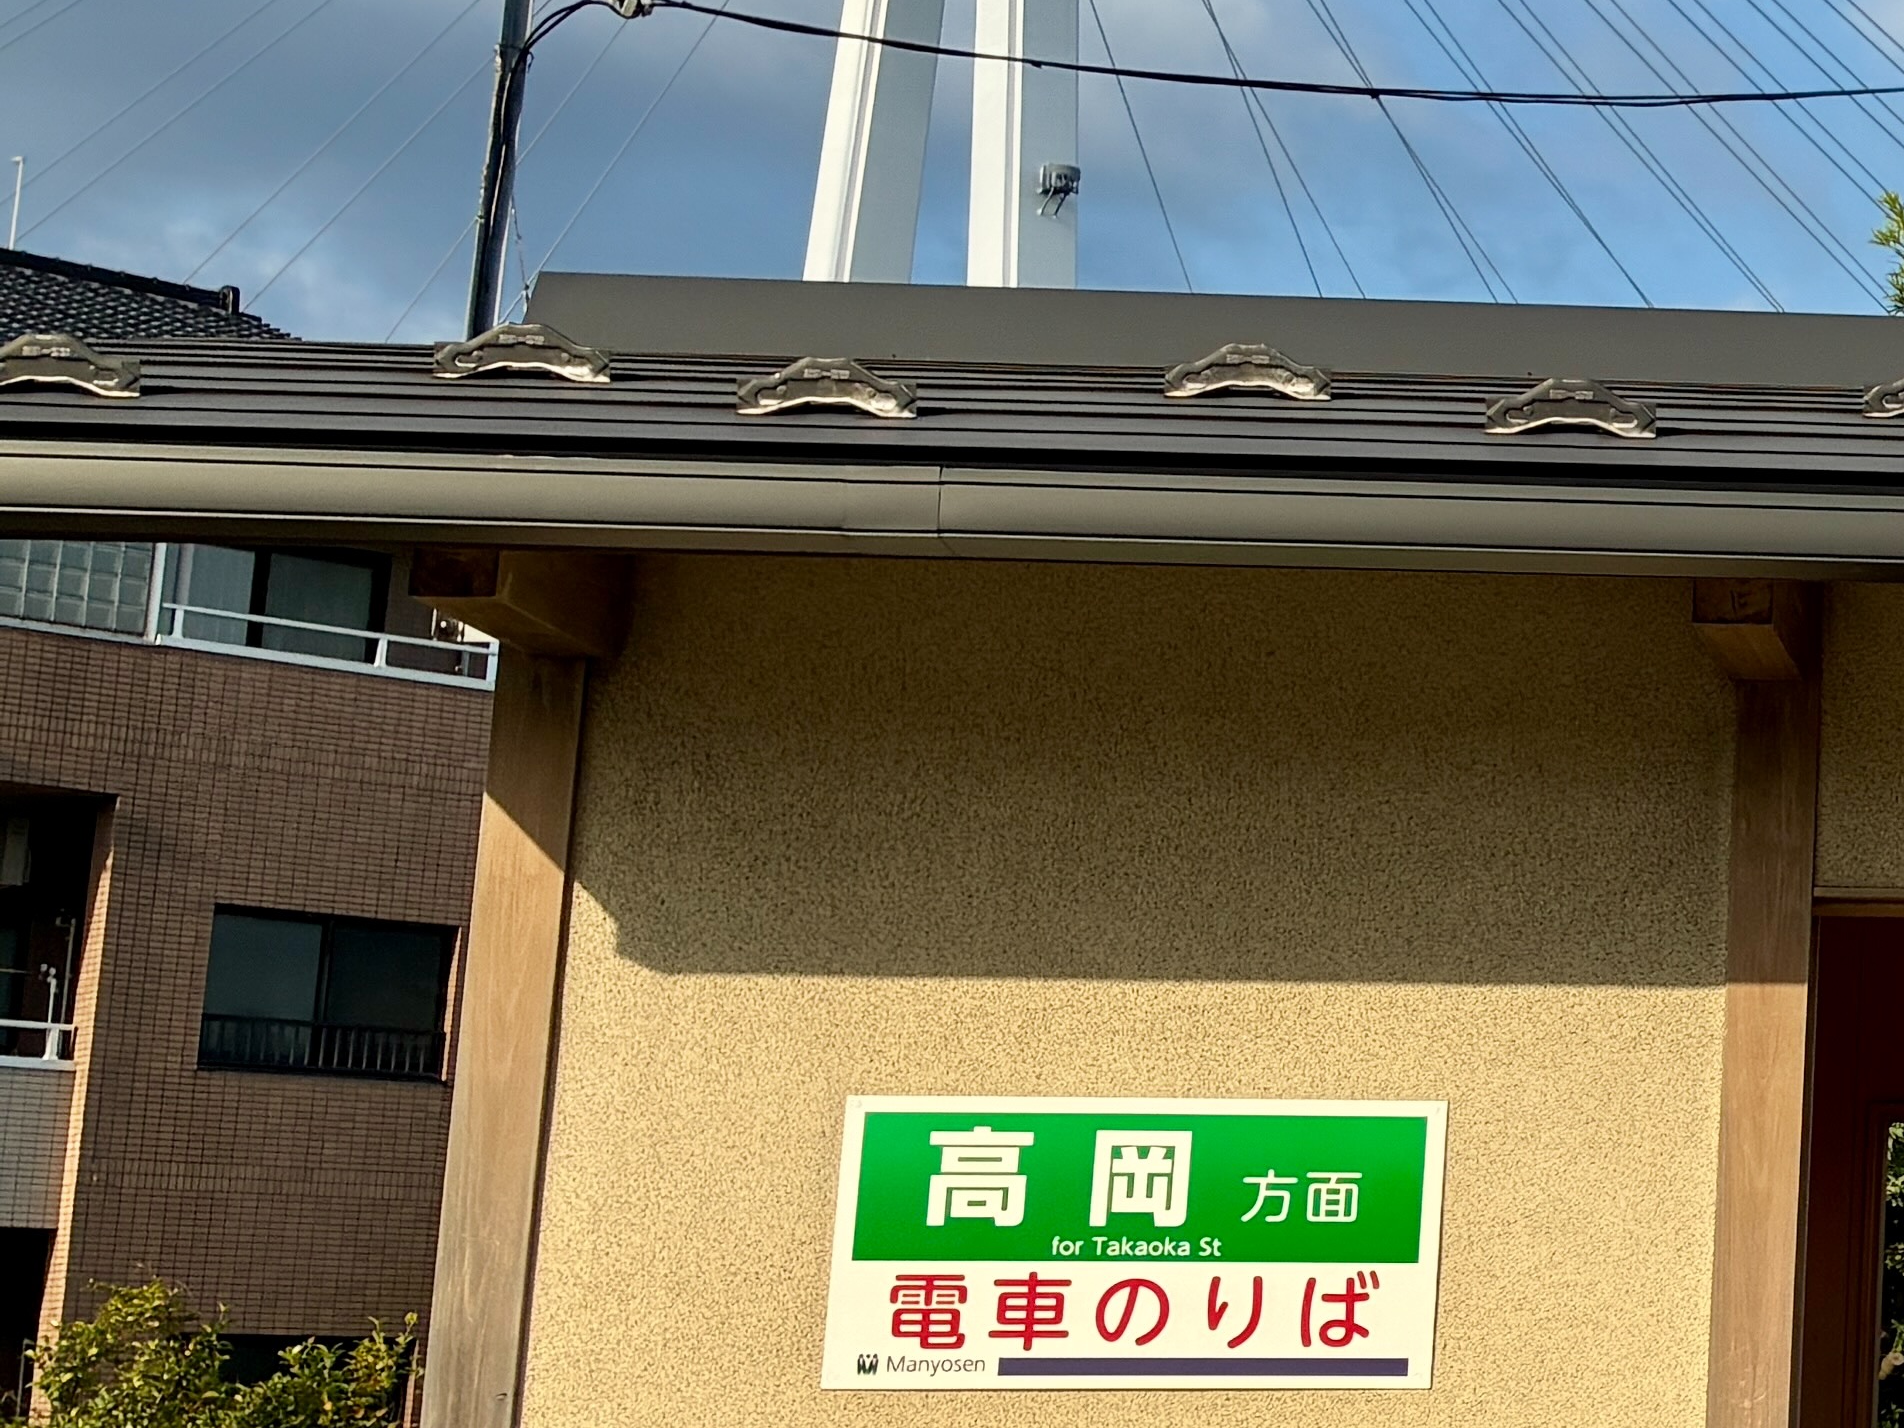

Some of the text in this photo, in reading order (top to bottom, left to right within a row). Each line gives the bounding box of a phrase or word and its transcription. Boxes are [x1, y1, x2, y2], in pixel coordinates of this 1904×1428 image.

[926, 1126, 1363, 1228] 高岡 方面
[1051, 1235, 1222, 1259] for Takaoka St
[888, 1270, 1381, 1352] 電車のりば
[886, 1355, 986, 1378] Manyosen
